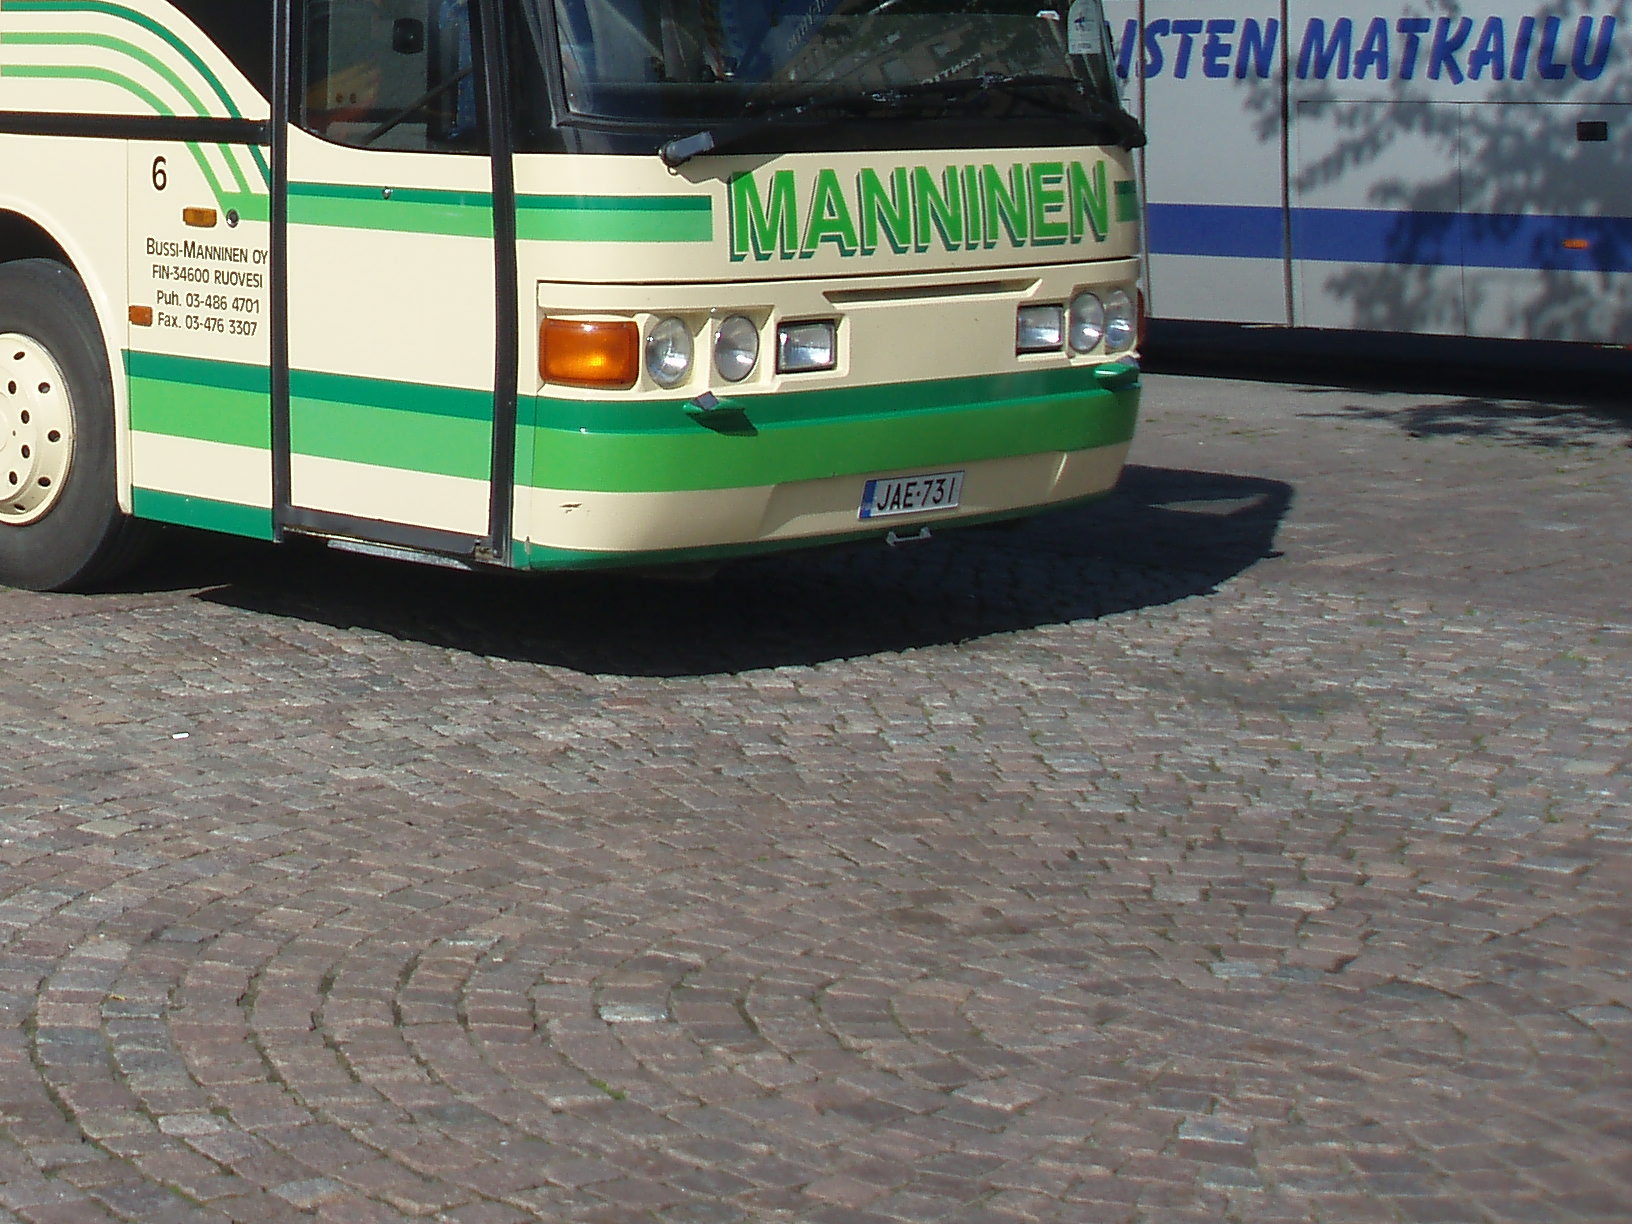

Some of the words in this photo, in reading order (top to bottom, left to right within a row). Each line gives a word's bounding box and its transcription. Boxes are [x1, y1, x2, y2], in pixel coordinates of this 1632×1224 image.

[1104, 18, 1278, 79] ISTEN
[1297, 15, 1616, 84] MATKAILU
[152, 156, 167, 191] 6
[728, 160, 1108, 262] MANNINEN
[252, 250, 268, 265] OY
[152, 264, 210, 284] FIN-34600
[214, 270, 263, 289] RUOVESI
[156, 290, 182, 307] Puh.
[185, 292, 228, 311] 03-486
[232, 297, 260, 314] 4701
[158, 312, 182, 329] Fax.
[185, 315, 225, 333] 03-476
[229, 319, 258, 337] 3307
[876, 478, 956, 511] JAE-731
